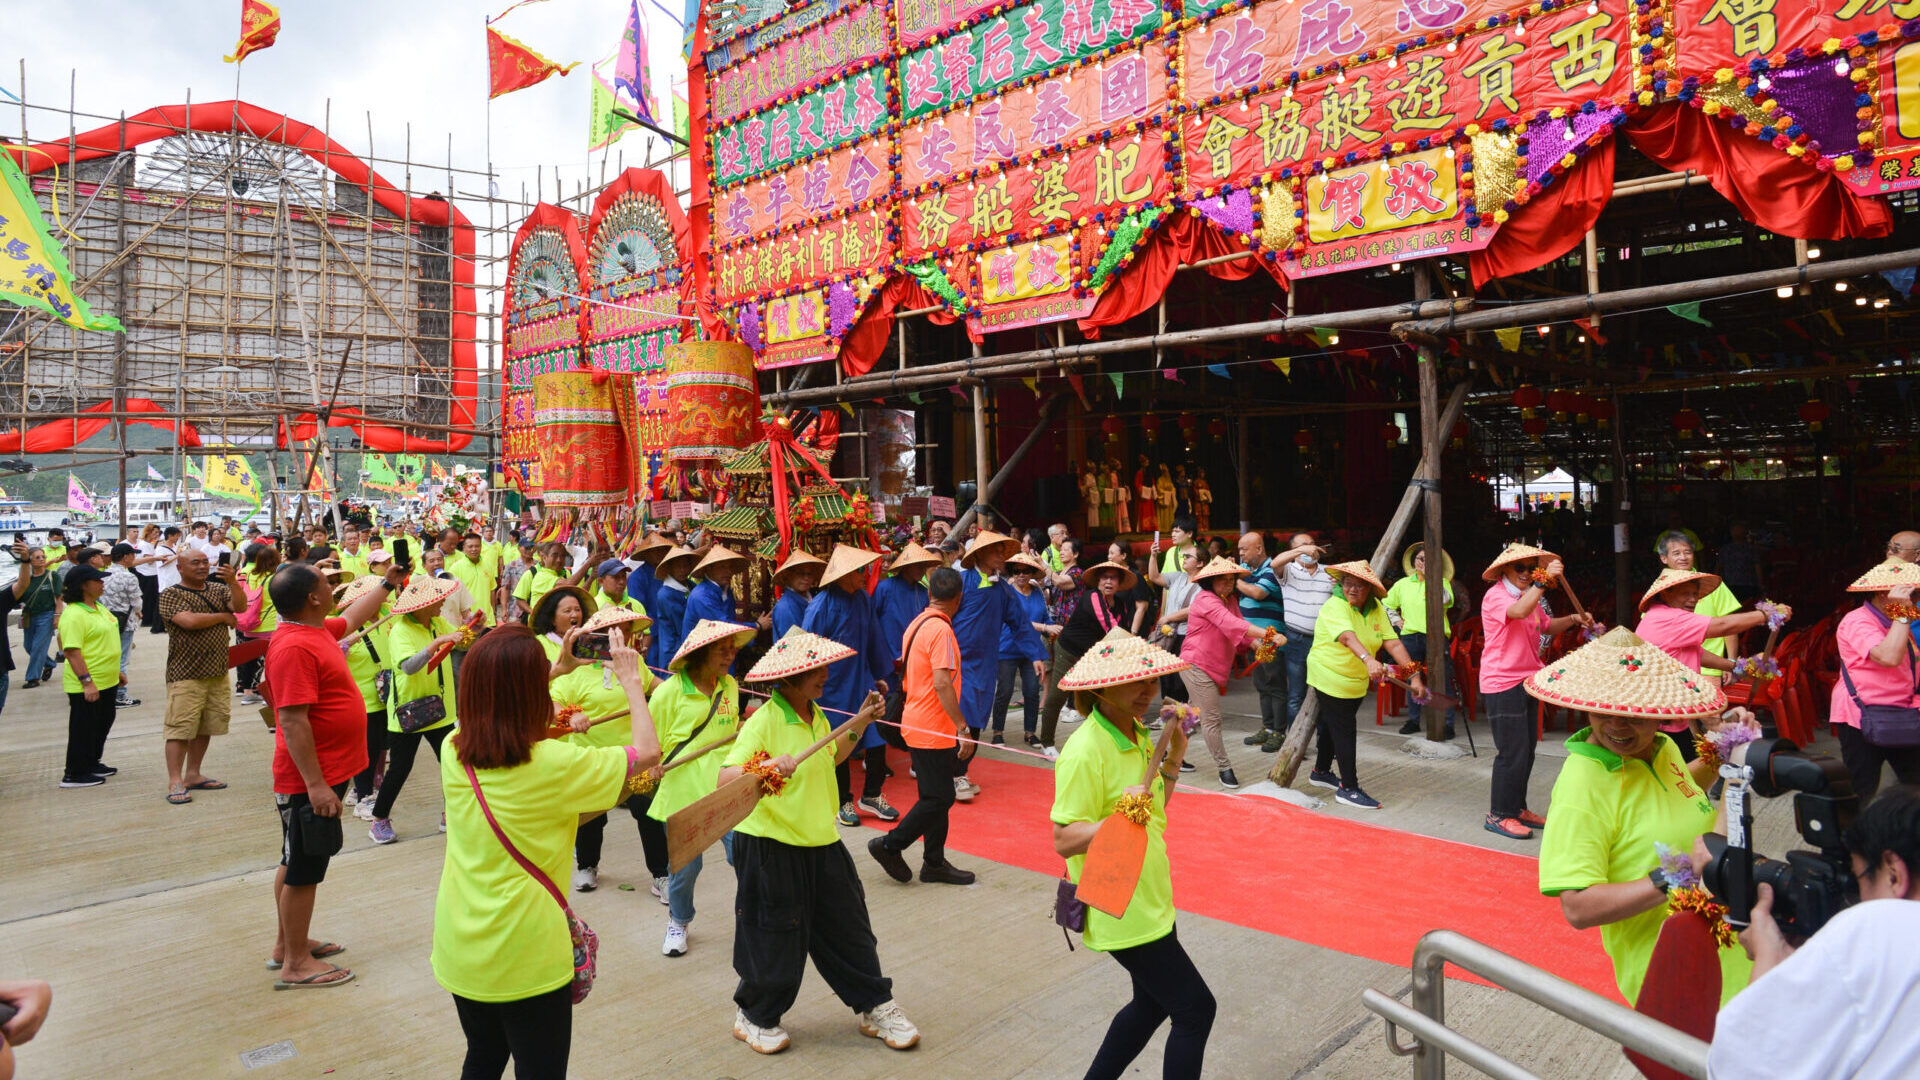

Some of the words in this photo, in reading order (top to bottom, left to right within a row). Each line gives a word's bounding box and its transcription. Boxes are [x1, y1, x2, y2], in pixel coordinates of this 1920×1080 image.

[717, 76, 885, 179] 恭祝天后寶誕
[916, 54, 1149, 178] 國泰民安
[1197, 11, 1618, 179] 西貢遊艇協會
[724, 148, 880, 237] 合境平安
[917, 143, 1153, 250] 肥婆船務
[1321, 159, 1447, 231] 敬賀
[720, 213, 886, 298] 沙橋有利海鮮漁村
[988, 245, 1066, 298] 敬賀
[770, 298, 821, 339] 敬賀
